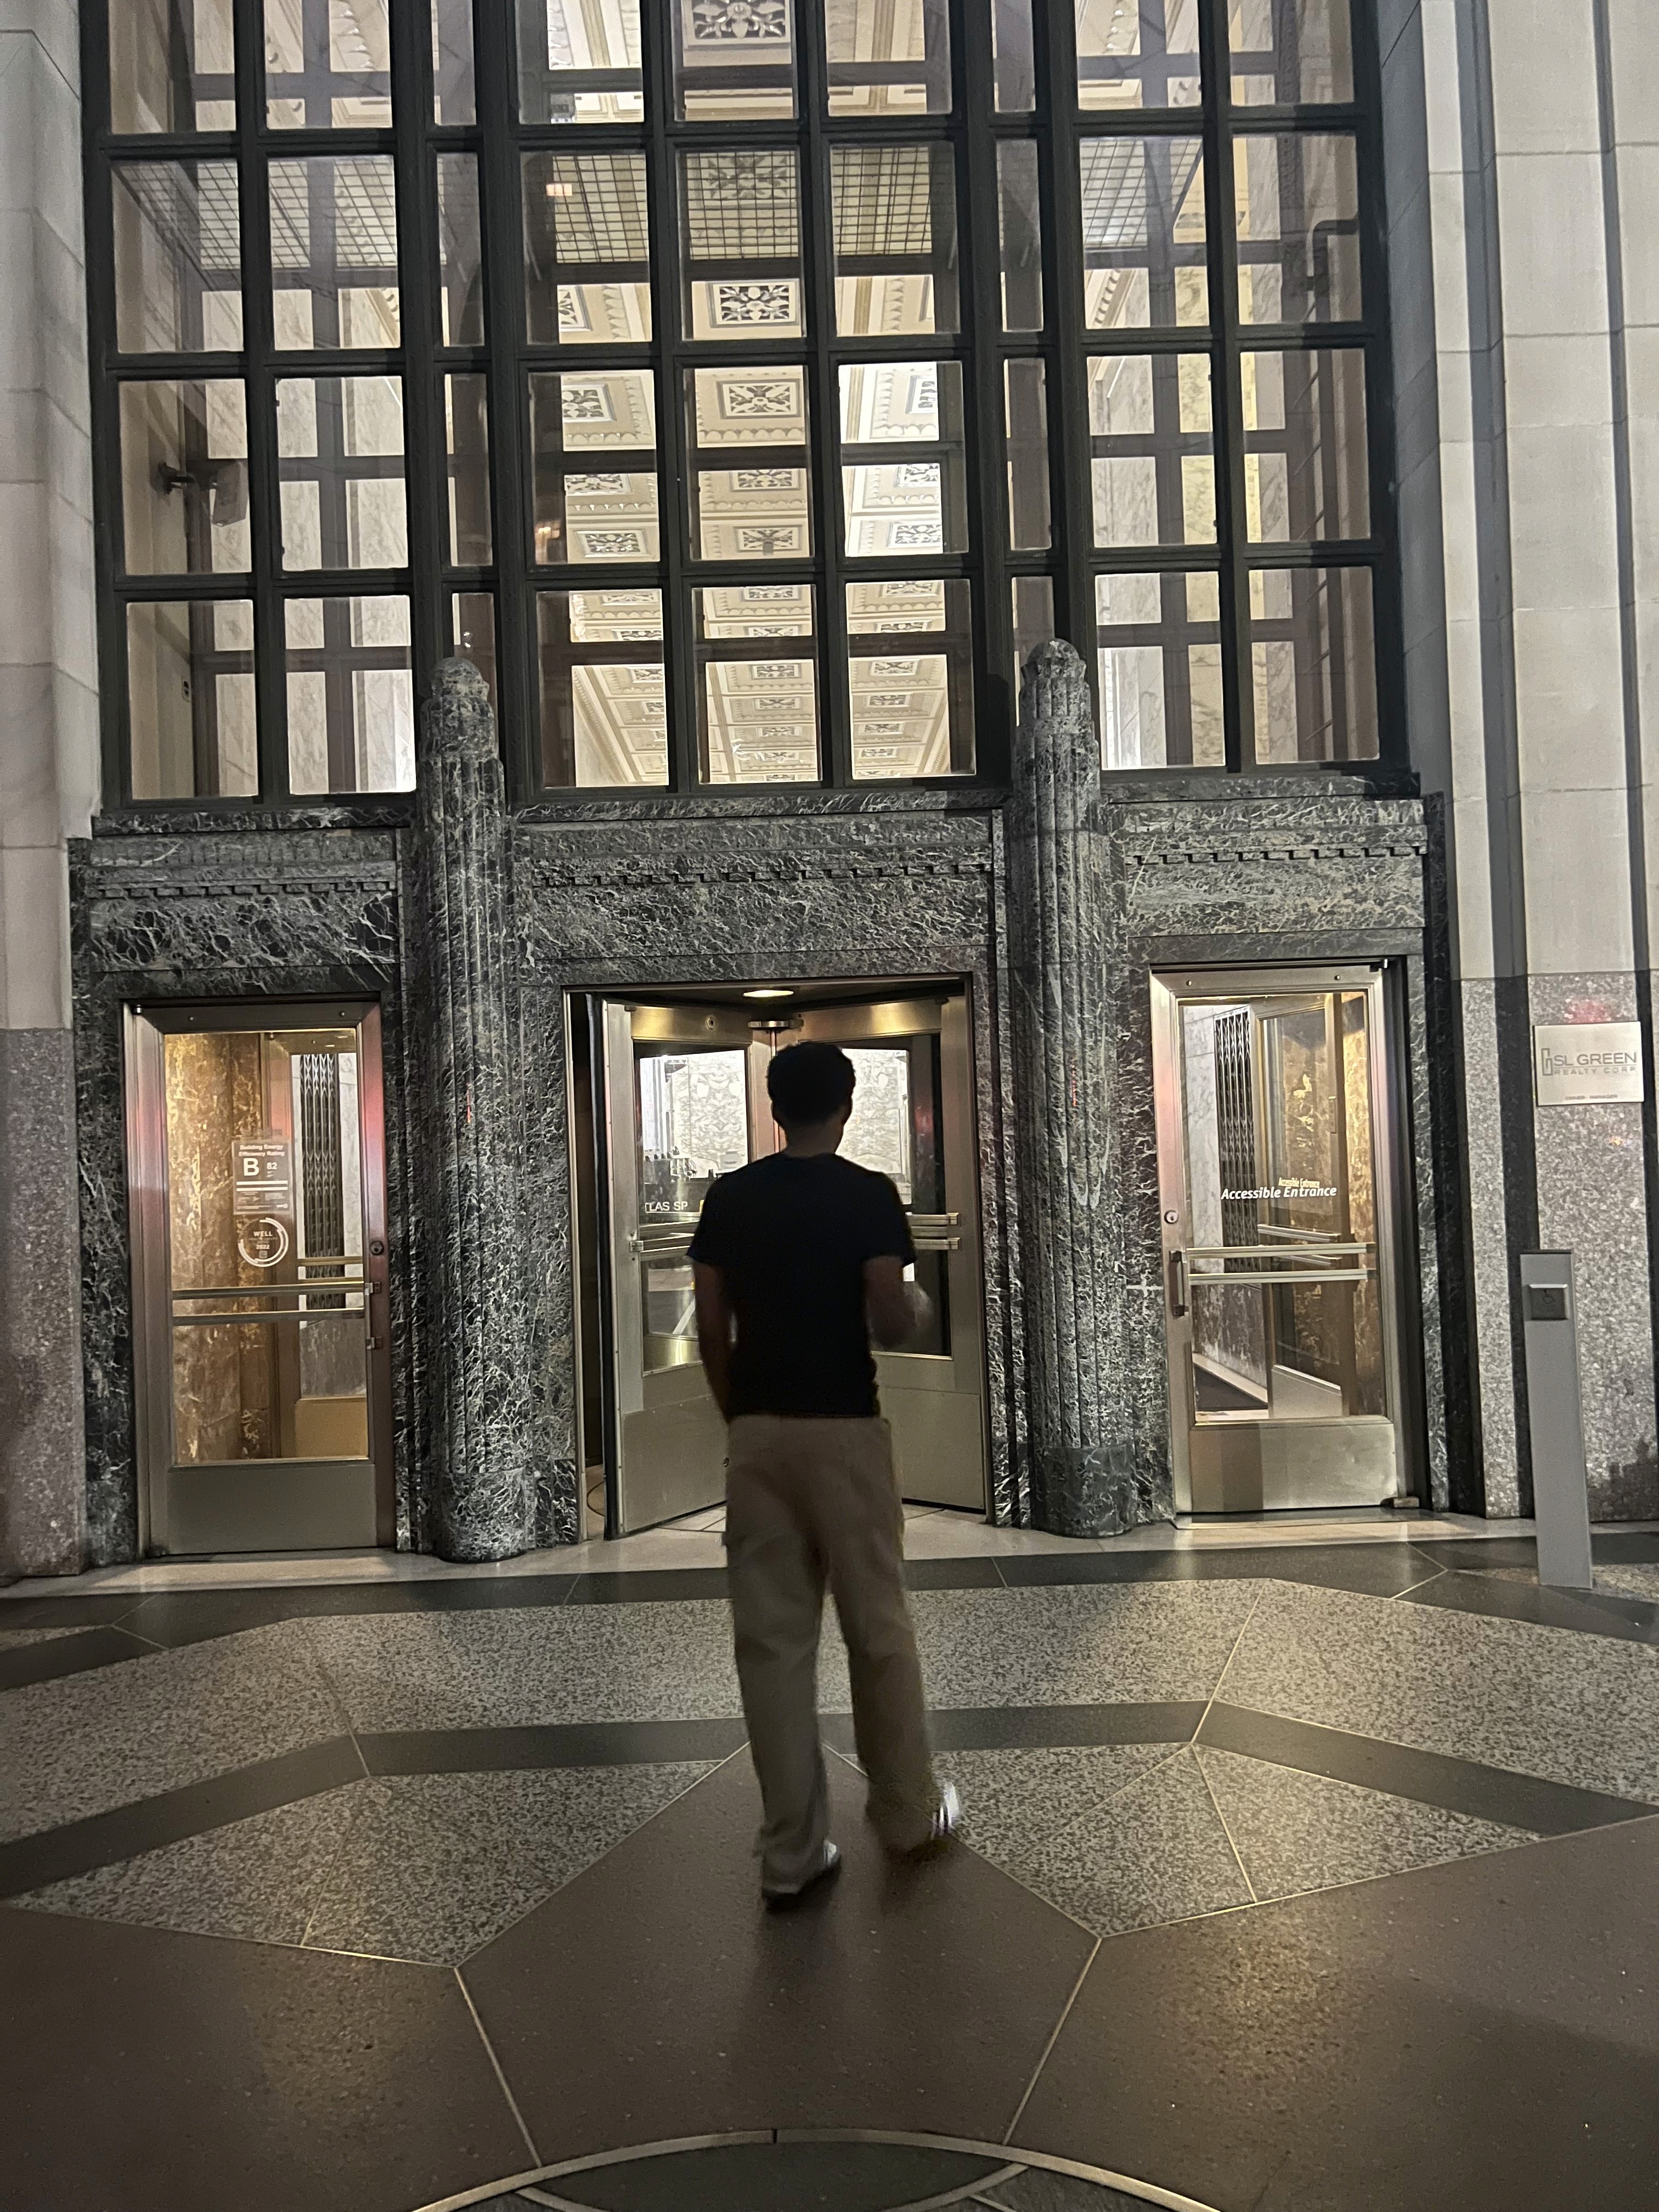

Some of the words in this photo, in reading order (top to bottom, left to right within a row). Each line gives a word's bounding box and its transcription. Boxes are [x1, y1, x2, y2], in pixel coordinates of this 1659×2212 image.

[1554, 1055, 1574, 1066] SL
[1576, 1052, 1637, 1065] GREEN
[244, 1158, 259, 1176] B
[1221, 1186, 1281, 1200] Accessible
[1284, 1187, 1337, 1198] Entrance
[674, 1201, 688, 1210] SP
